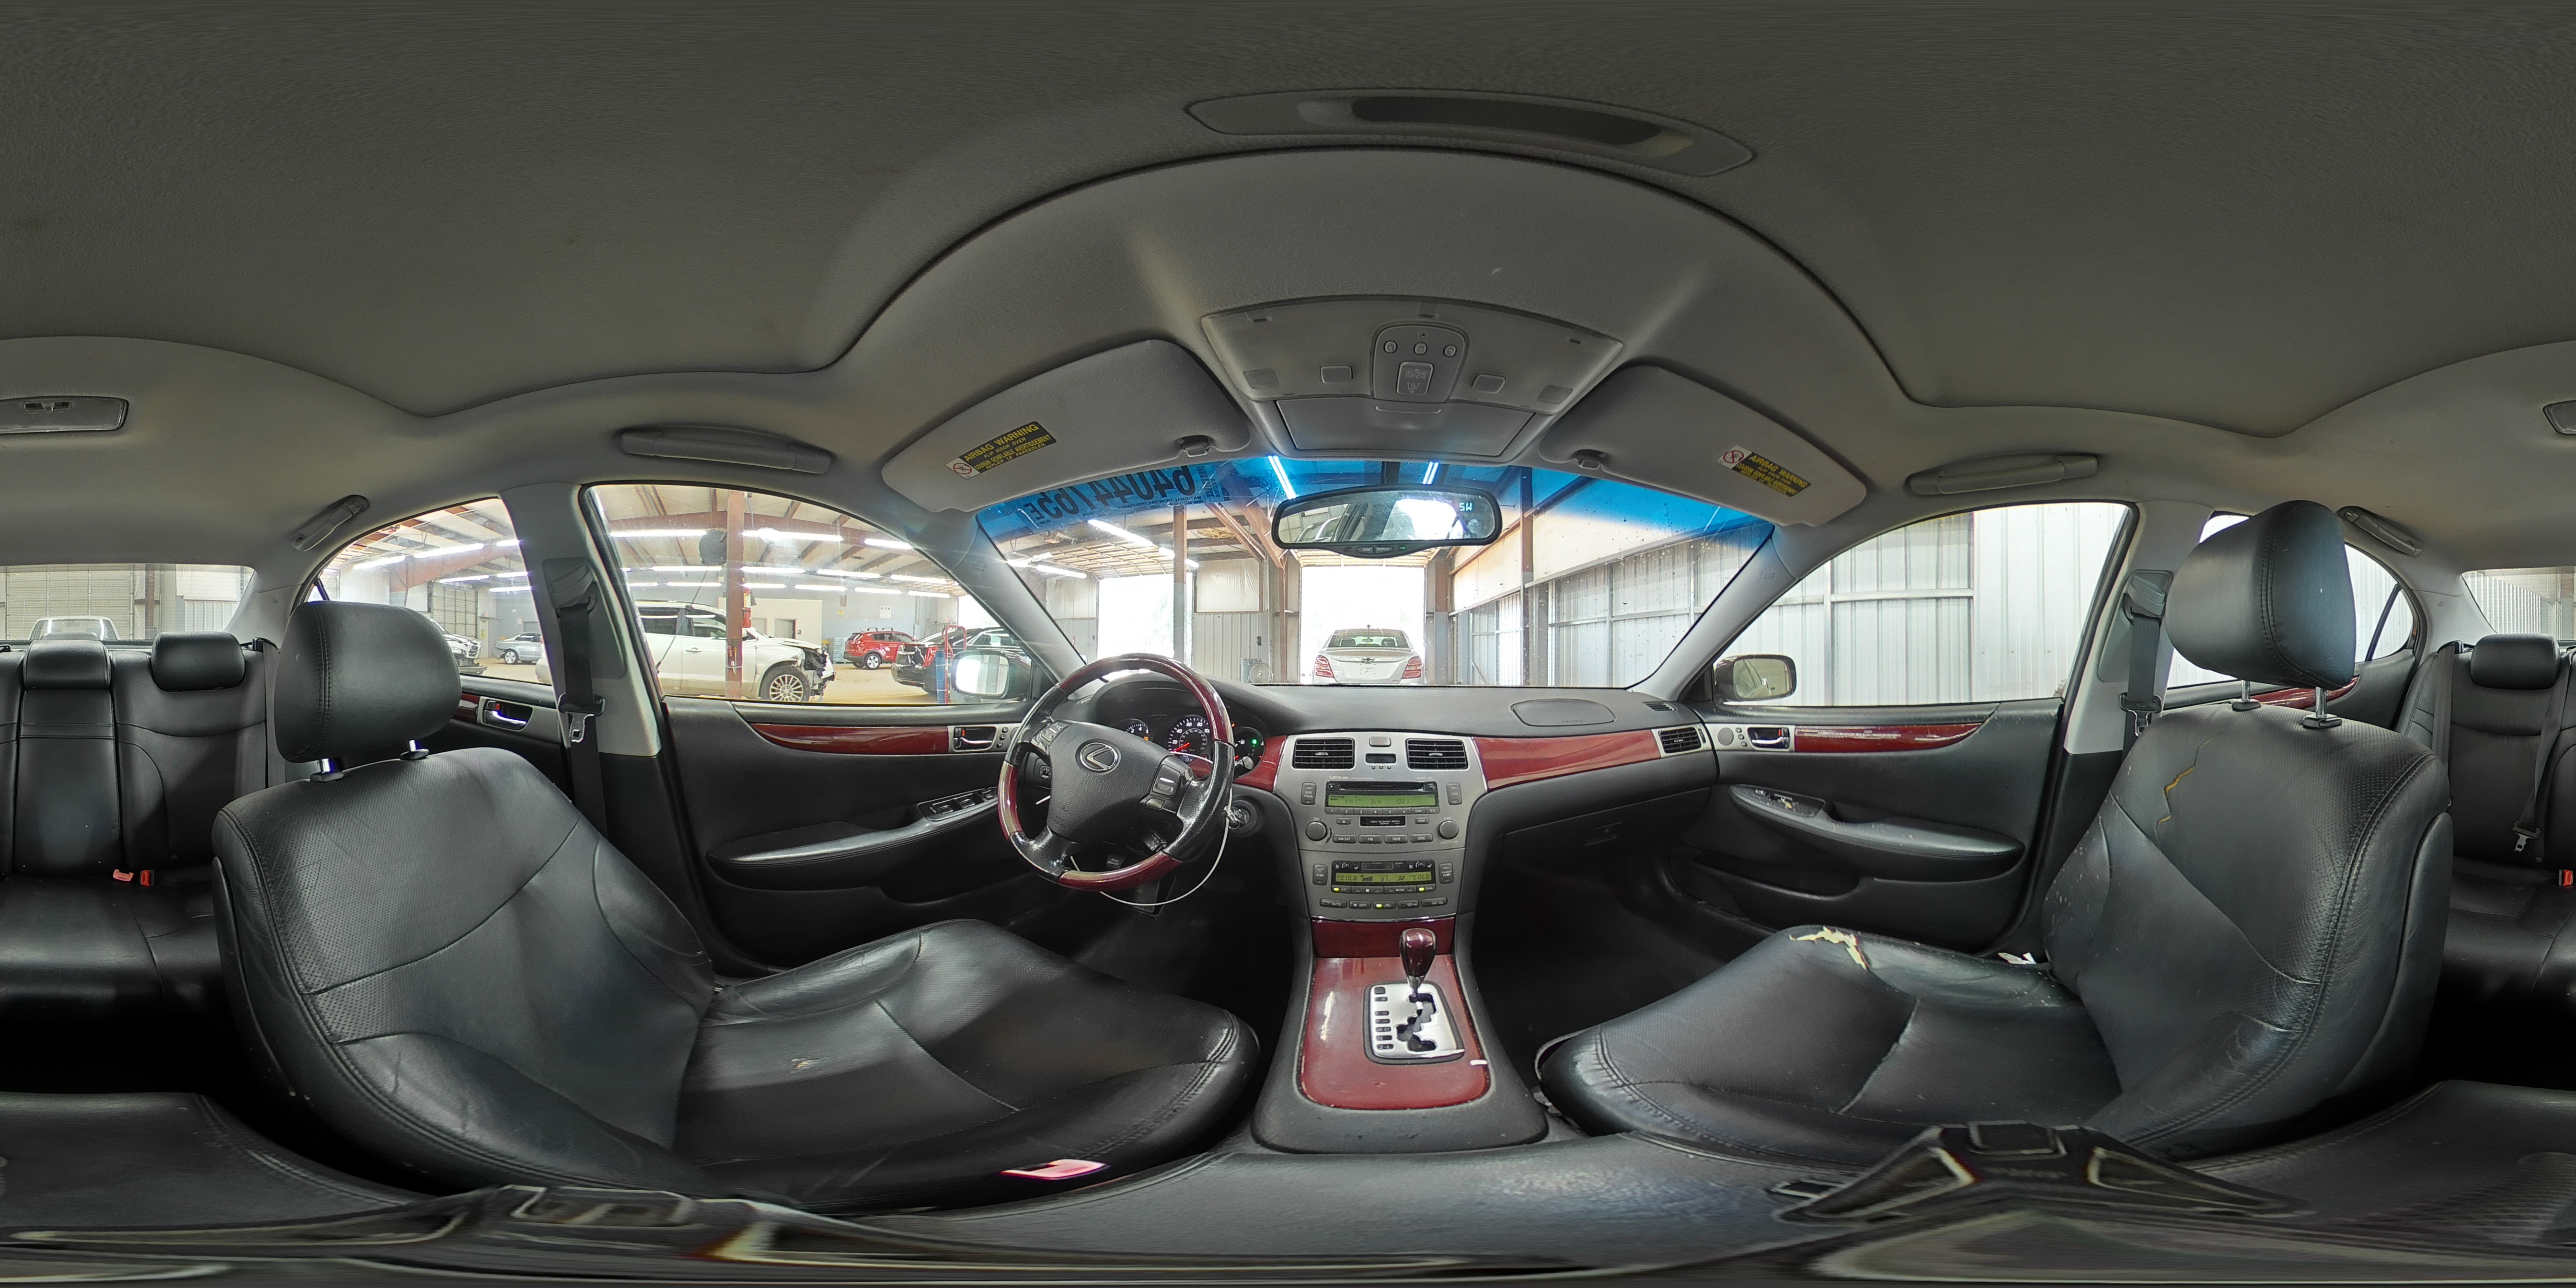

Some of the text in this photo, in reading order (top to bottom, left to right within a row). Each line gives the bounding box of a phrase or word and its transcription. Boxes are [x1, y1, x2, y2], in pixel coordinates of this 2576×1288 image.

[964, 424, 1039, 461] AIRBAG WARNING
[995, 444, 1010, 453] VISOR
[1012, 437, 1026, 446] OVER
[1749, 455, 1779, 472] AIRBAG
[1459, 502, 1472, 511] SW
